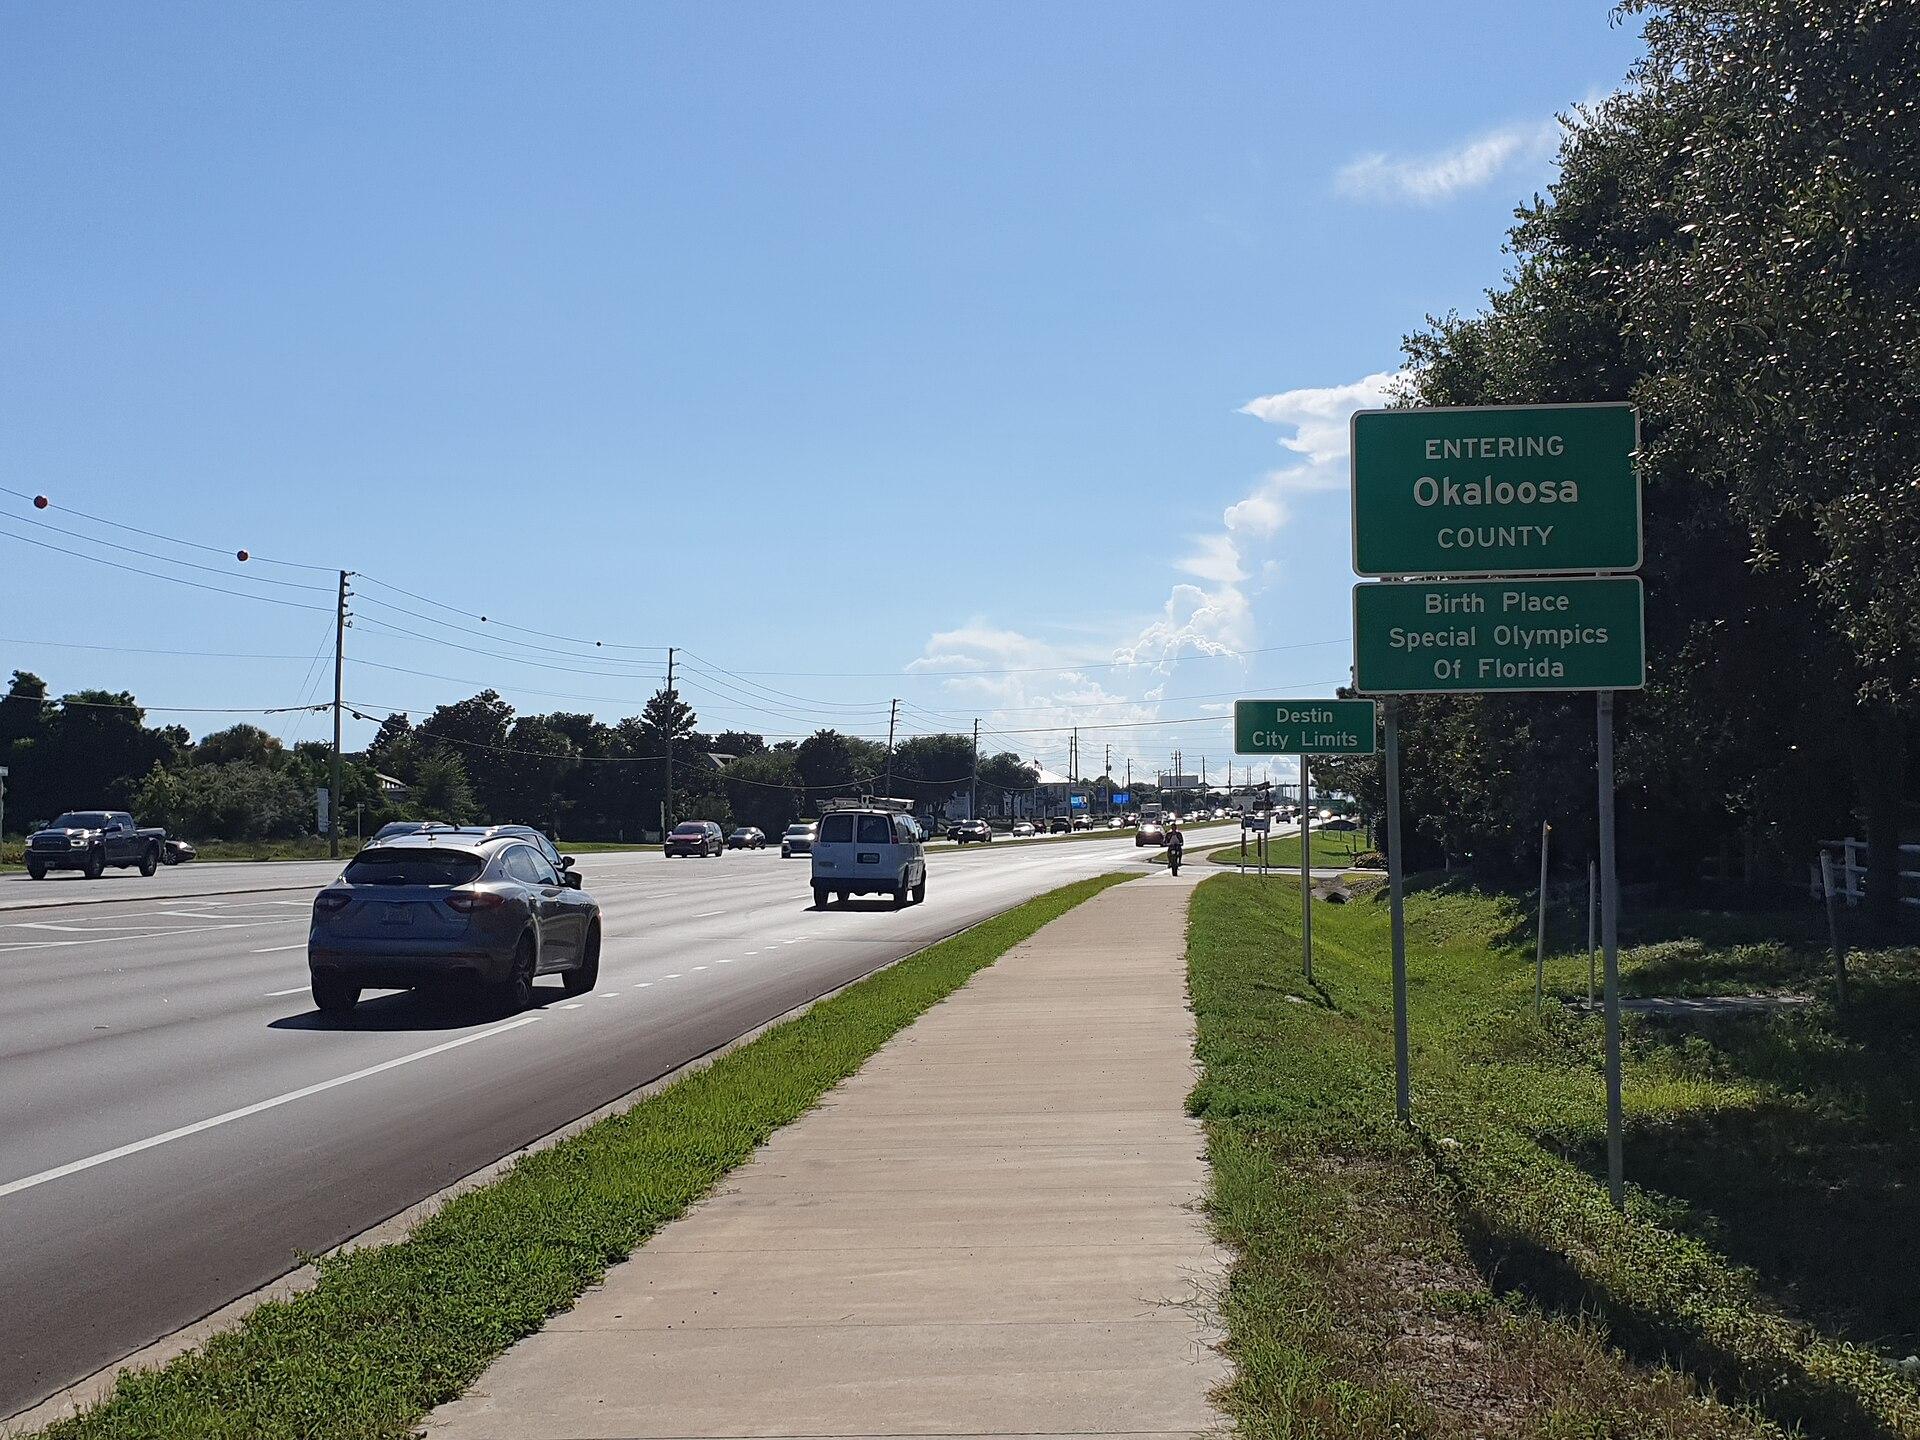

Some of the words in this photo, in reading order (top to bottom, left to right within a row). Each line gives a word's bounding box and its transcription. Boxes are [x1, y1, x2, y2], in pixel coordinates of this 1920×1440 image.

[1425, 436, 1564, 459] ENTERING
[1413, 476, 1578, 506] Okaloosa
[1437, 525, 1554, 548] COUNTY
[1425, 593, 1485, 614] Birth
[1502, 591, 1570, 612] Place
[1389, 626, 1476, 652] Special
[1493, 624, 1609, 650] Olympics
[1433, 659, 1461, 680] Of
[1478, 657, 1564, 678] Florida
[1276, 708, 1333, 723] Destin
[1252, 731, 1289, 750] City
[1301, 731, 1358, 746] Limits
